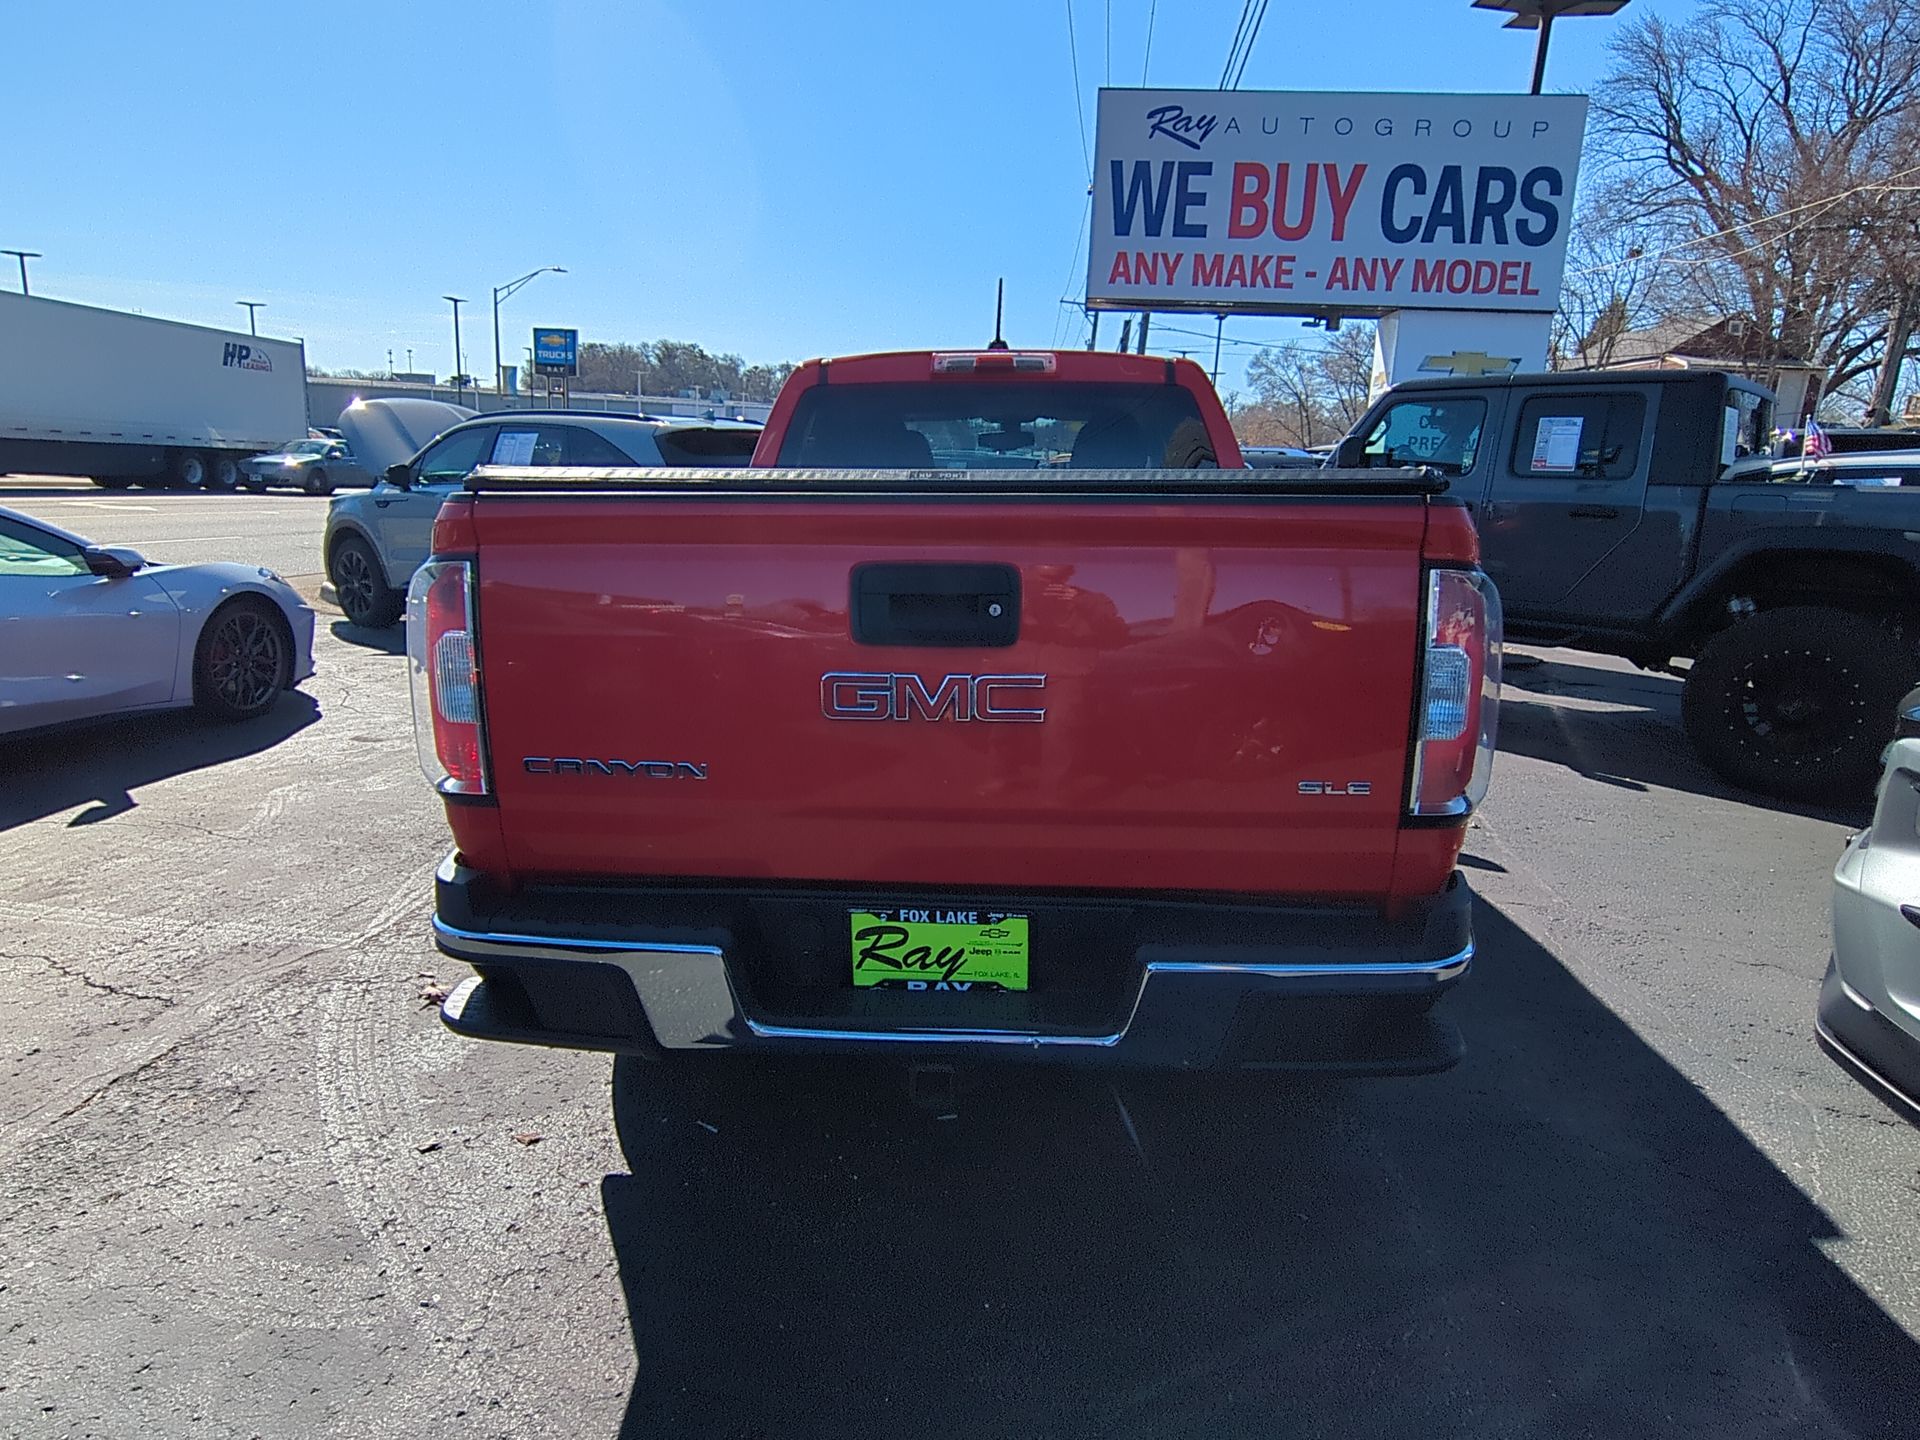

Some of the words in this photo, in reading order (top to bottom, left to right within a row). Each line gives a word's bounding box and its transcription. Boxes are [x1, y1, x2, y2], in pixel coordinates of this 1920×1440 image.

[1146, 105, 1219, 150] Ray
[1110, 159, 1214, 238] WE
[1228, 162, 1368, 242] BUY
[1380, 162, 1564, 247] CARS
[1108, 251, 1183, 286] ANY
[1191, 253, 1297, 290] MAKE
[1325, 257, 1405, 292] ANY
[1411, 259, 1540, 296] MODEL
[222, 342, 251, 368] HP
[537, 350, 574, 360] TRUCKS
[820, 671, 1047, 723] GMC
[522, 756, 708, 780] CANYON
[1297, 780, 1372, 795] SLE
[899, 909, 930, 923] FOX
[936, 909, 978, 924] LAKE
[854, 925, 969, 981] Ray
[968, 947, 992, 956] Jeep
